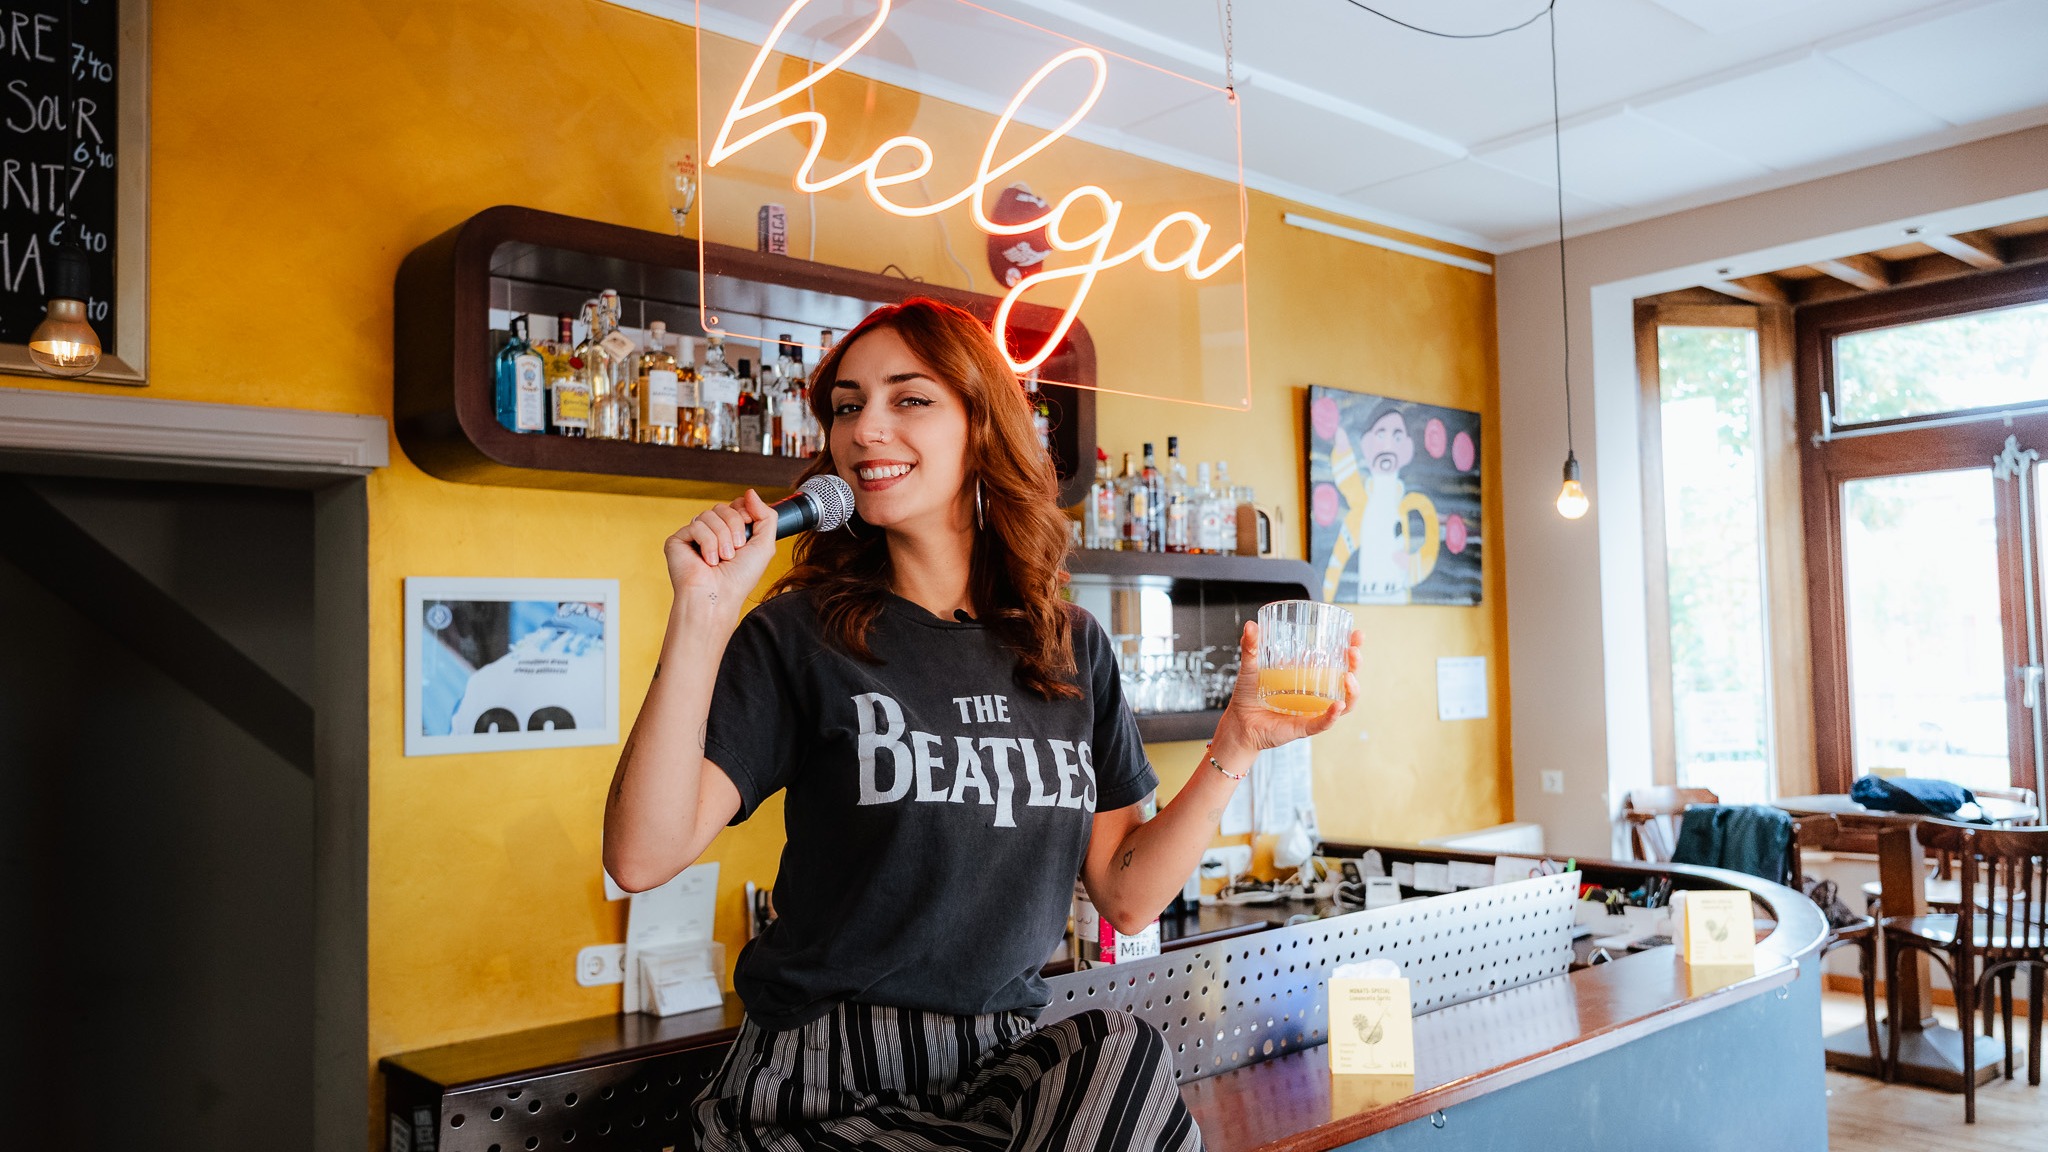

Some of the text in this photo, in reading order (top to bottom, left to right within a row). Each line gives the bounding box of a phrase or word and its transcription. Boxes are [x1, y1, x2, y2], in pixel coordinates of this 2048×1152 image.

[72, 42, 114, 83] 7,40
[73, 142, 114, 170] 6,40
[706, 0, 1244, 373] helga
[952, 694, 1011, 724] THE
[850, 692, 1097, 828] BEATLES
